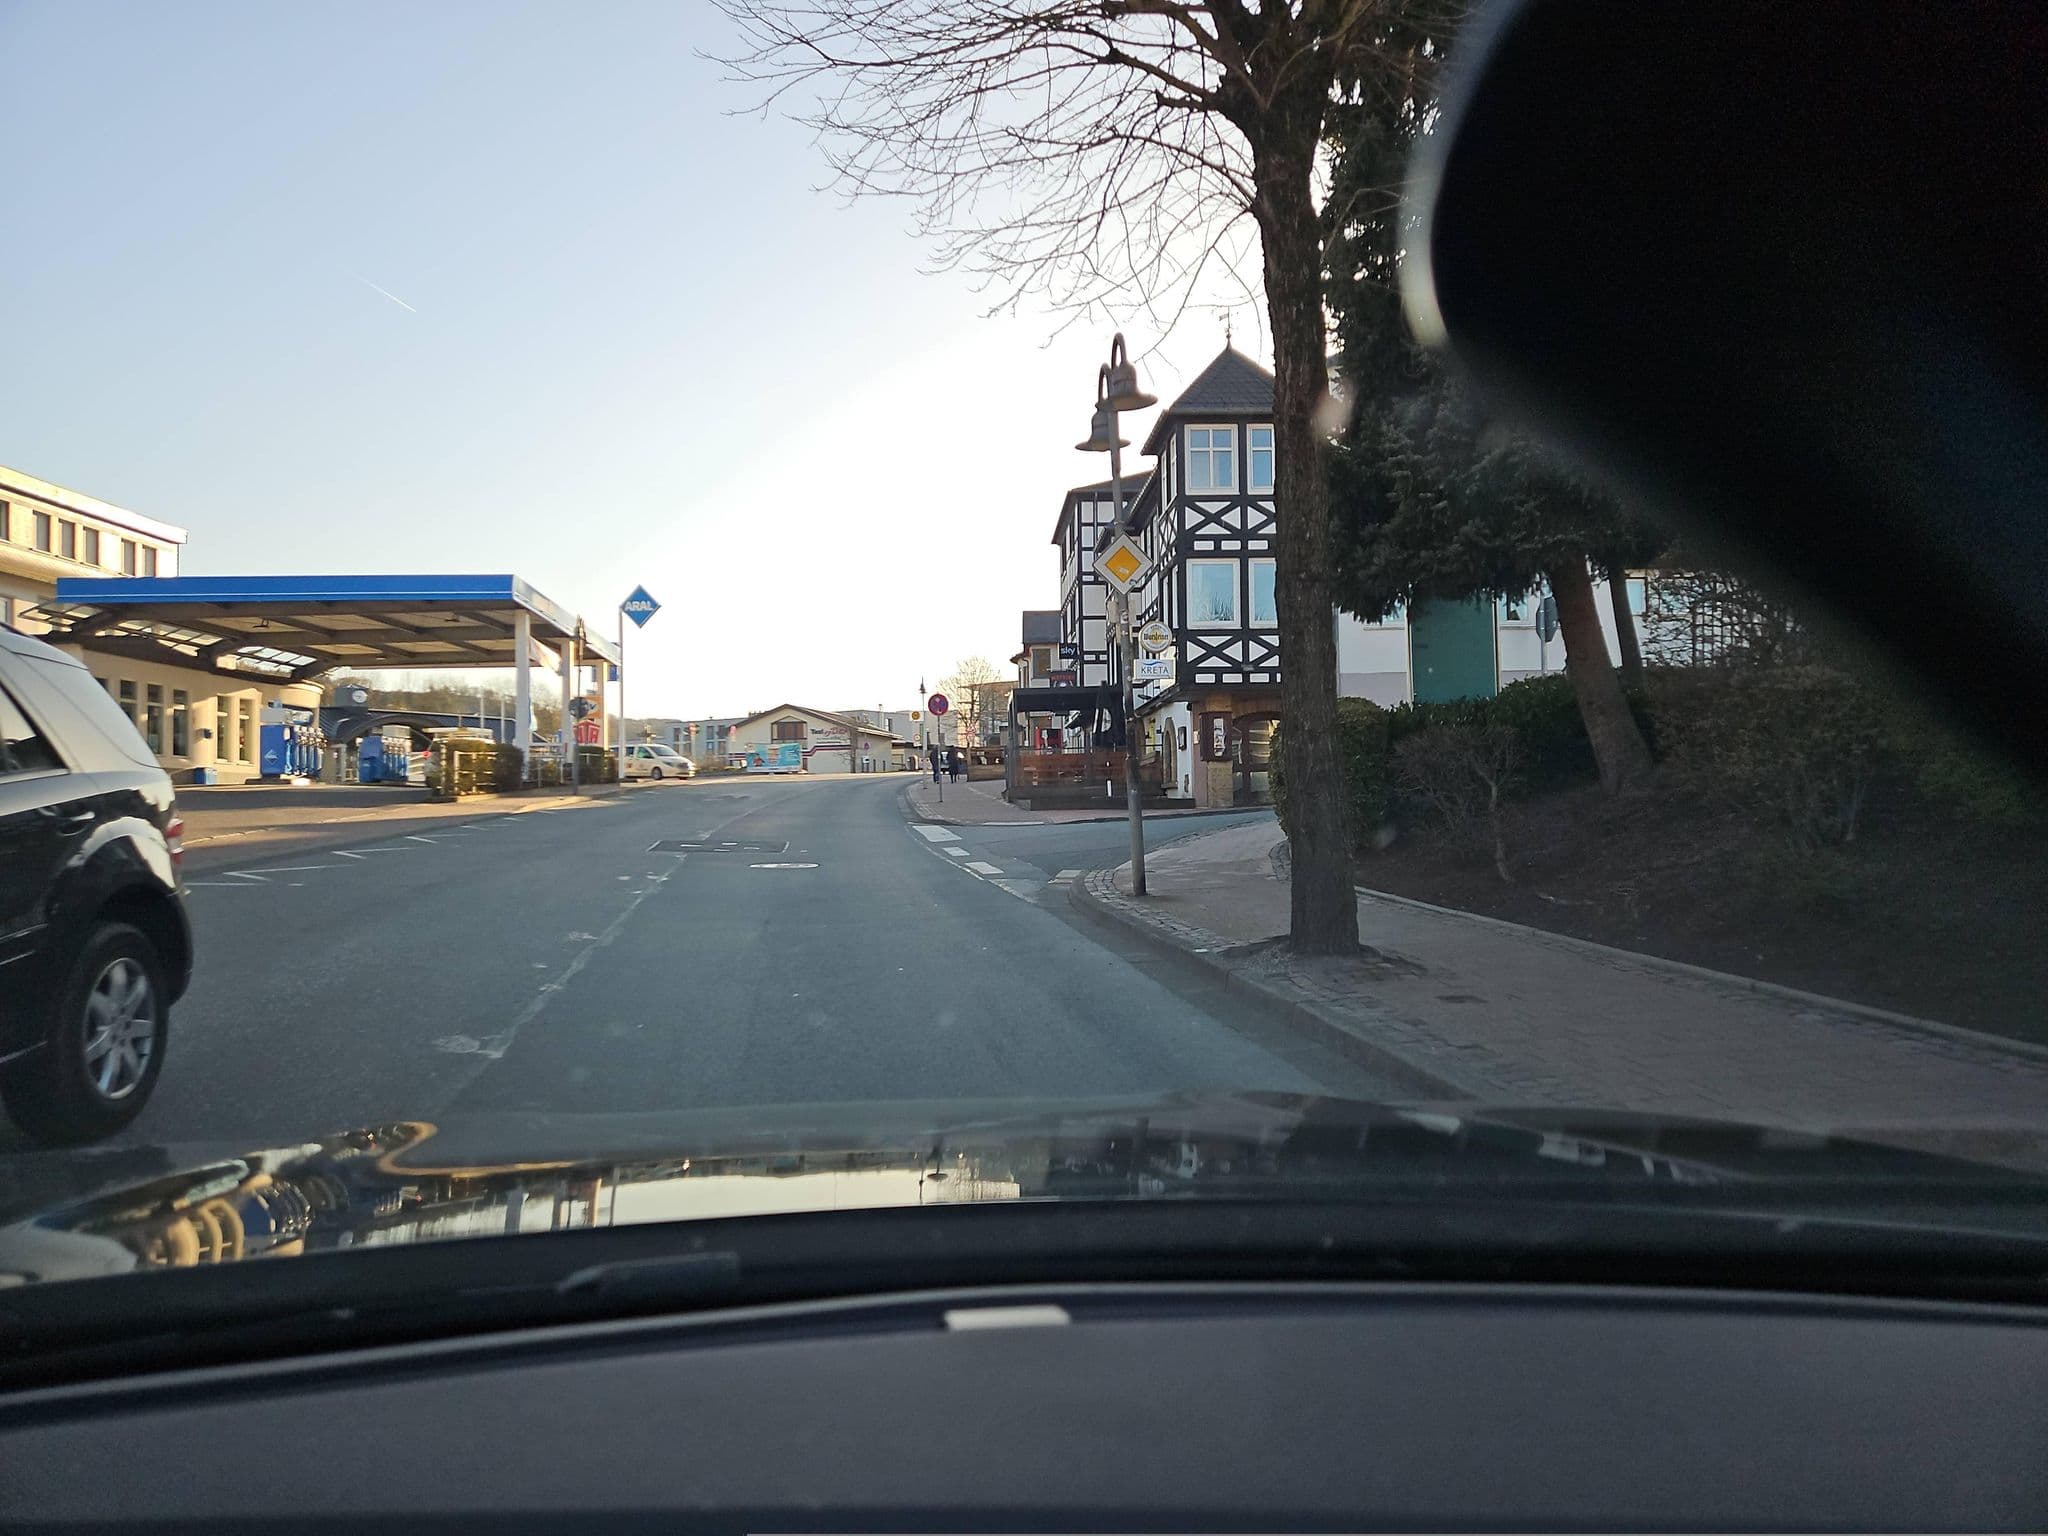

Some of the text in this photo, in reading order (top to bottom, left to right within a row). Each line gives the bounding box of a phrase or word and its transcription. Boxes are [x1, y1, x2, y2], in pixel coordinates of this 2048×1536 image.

[624, 600, 654, 611] ARAL
[1060, 646, 1076, 655] sky
[1141, 666, 1169, 674] KRETA
